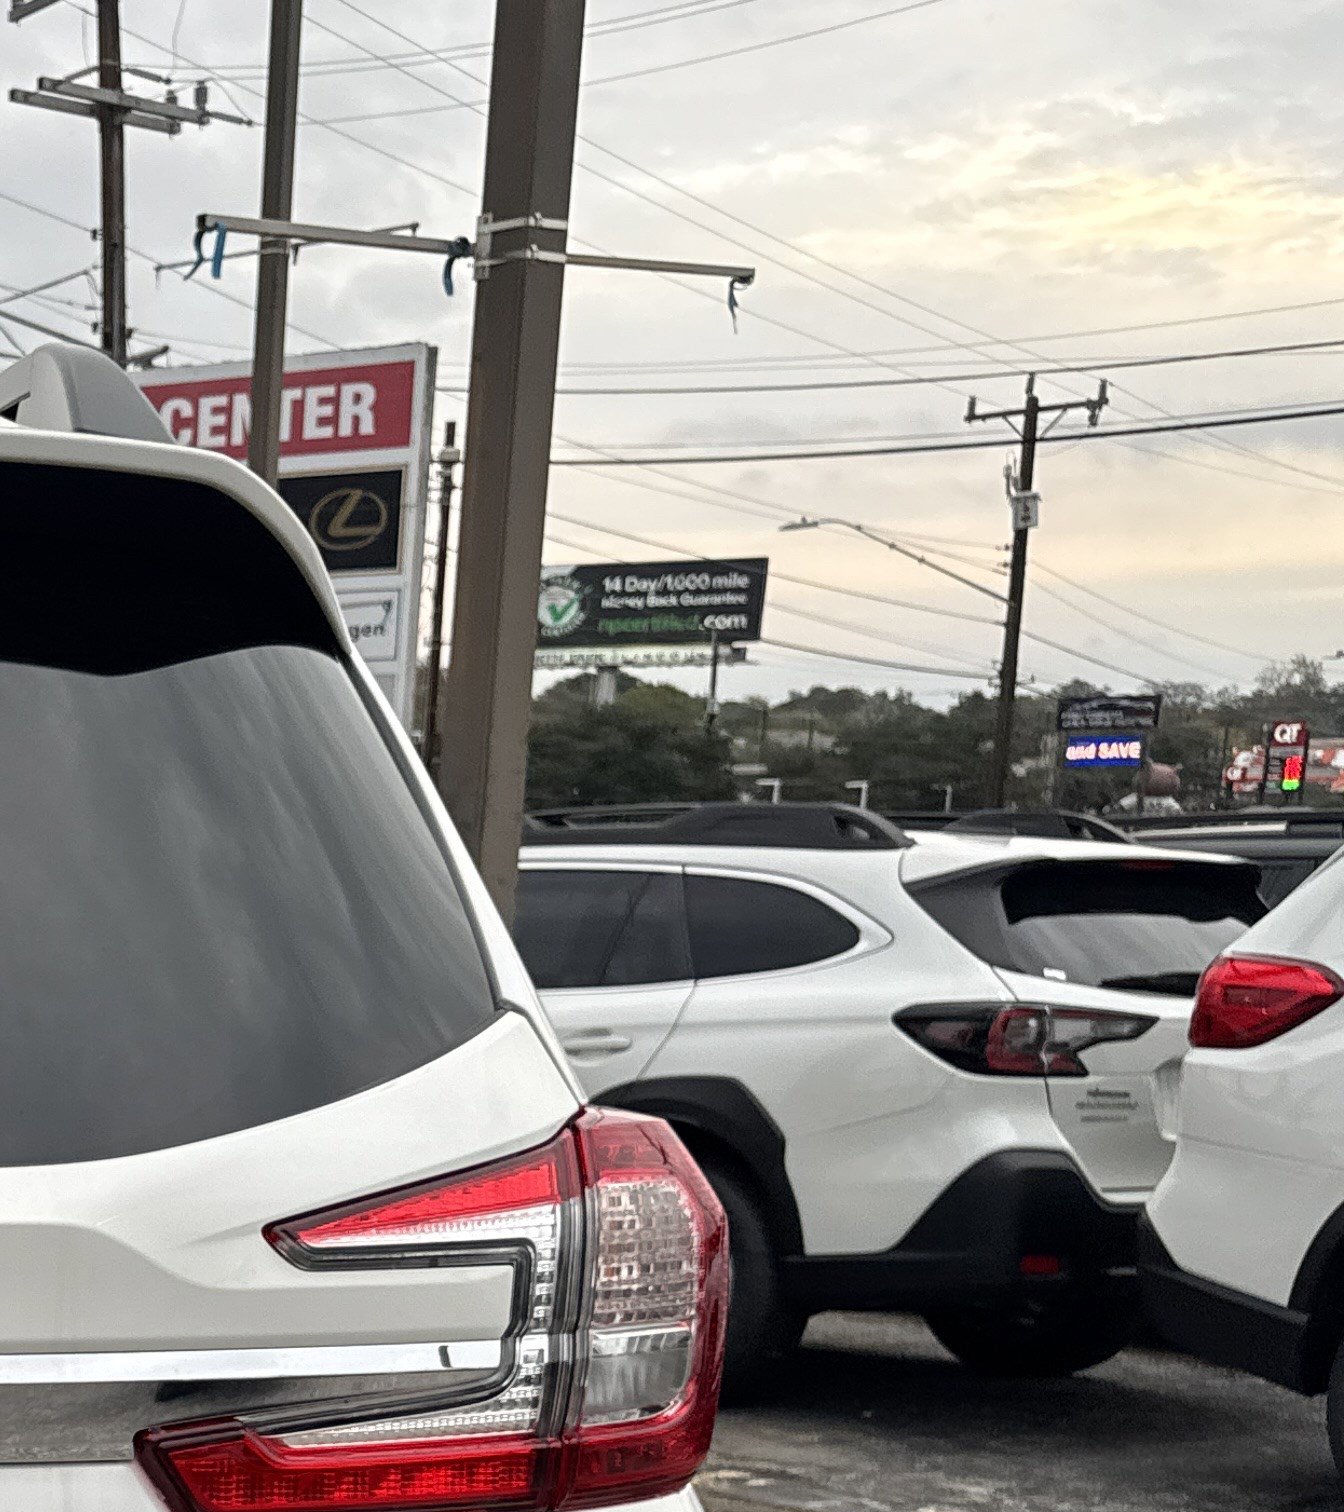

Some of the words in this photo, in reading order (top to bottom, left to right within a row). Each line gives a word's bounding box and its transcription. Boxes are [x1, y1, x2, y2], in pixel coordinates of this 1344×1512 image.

[160, 381, 377, 448] CENTER
[602, 575, 622, 593] 14
[712, 571, 750, 589] mile
[1273, 723, 1303, 744] QT
[1065, 742, 1097, 760] and
[1098, 741, 1141, 759] SAVE
